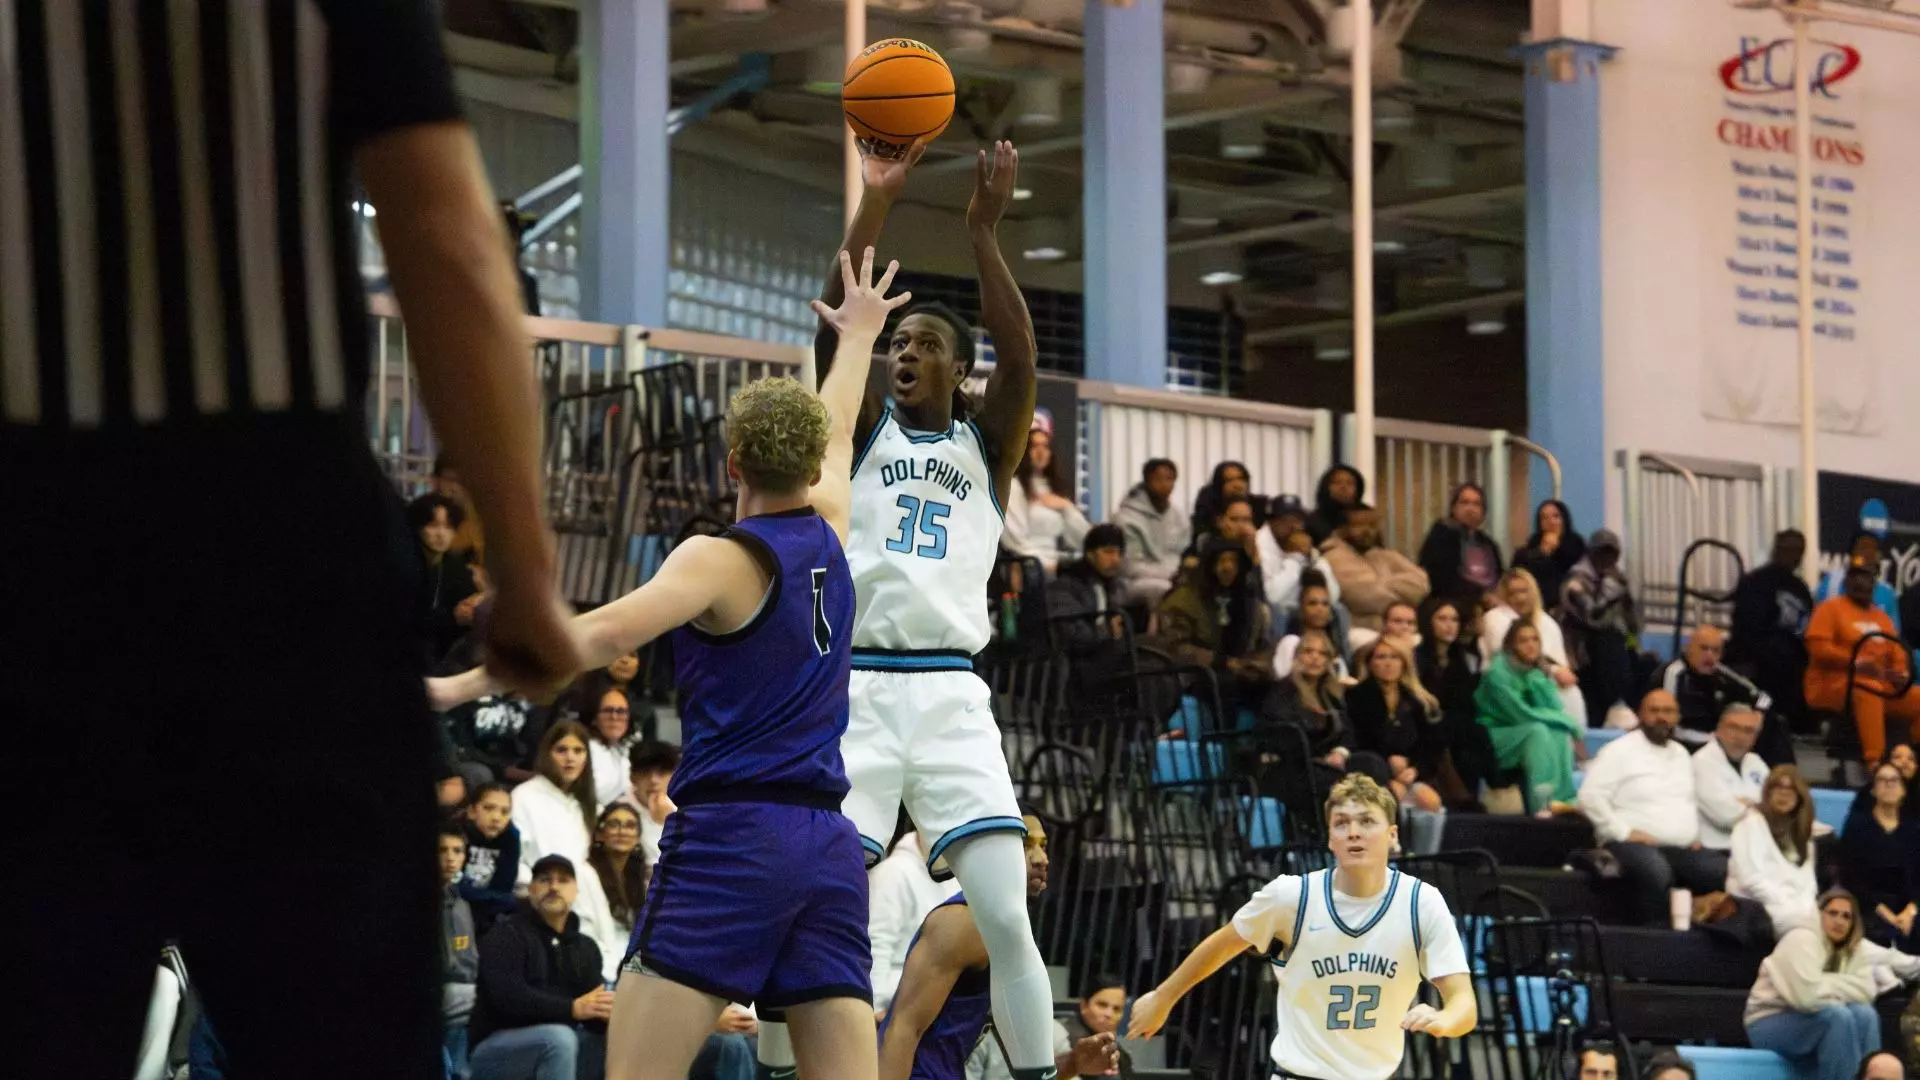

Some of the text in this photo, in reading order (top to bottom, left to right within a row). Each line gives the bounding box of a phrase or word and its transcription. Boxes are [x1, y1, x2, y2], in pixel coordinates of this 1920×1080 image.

[1738, 36, 1846, 99] ECC
[1717, 118, 1864, 165] CHAMONS
[880, 457, 972, 502] DOLPHINS
[886, 494, 951, 560] 35
[1311, 952, 1398, 979] DOLPHINS
[1326, 985, 1381, 1030] 22
